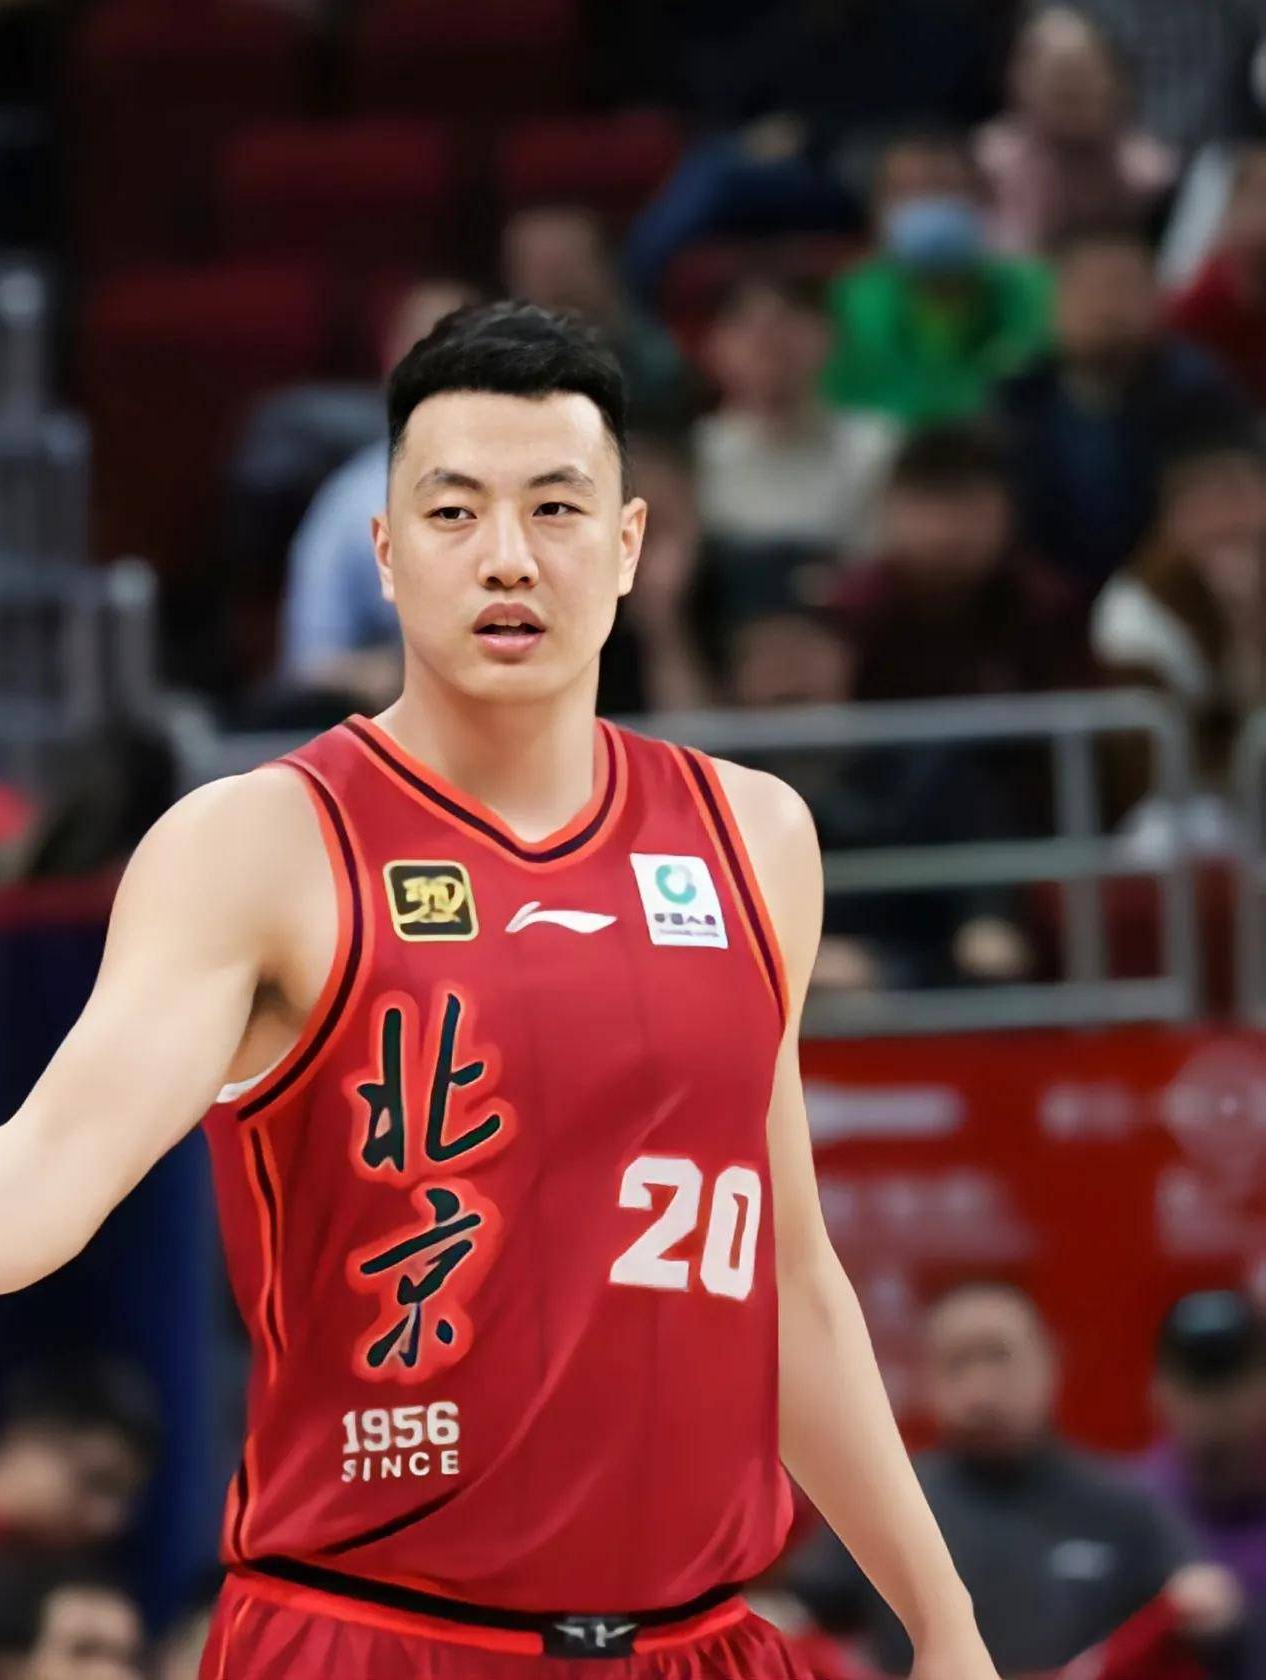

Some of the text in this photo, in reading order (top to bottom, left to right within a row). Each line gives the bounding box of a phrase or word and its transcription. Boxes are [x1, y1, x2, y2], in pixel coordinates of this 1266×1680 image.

[358, 993, 502, 1368] 北京
[609, 1155, 762, 1300] 20
[340, 1449, 461, 1484] SINCE
[341, 1400, 461, 1454] 1956
